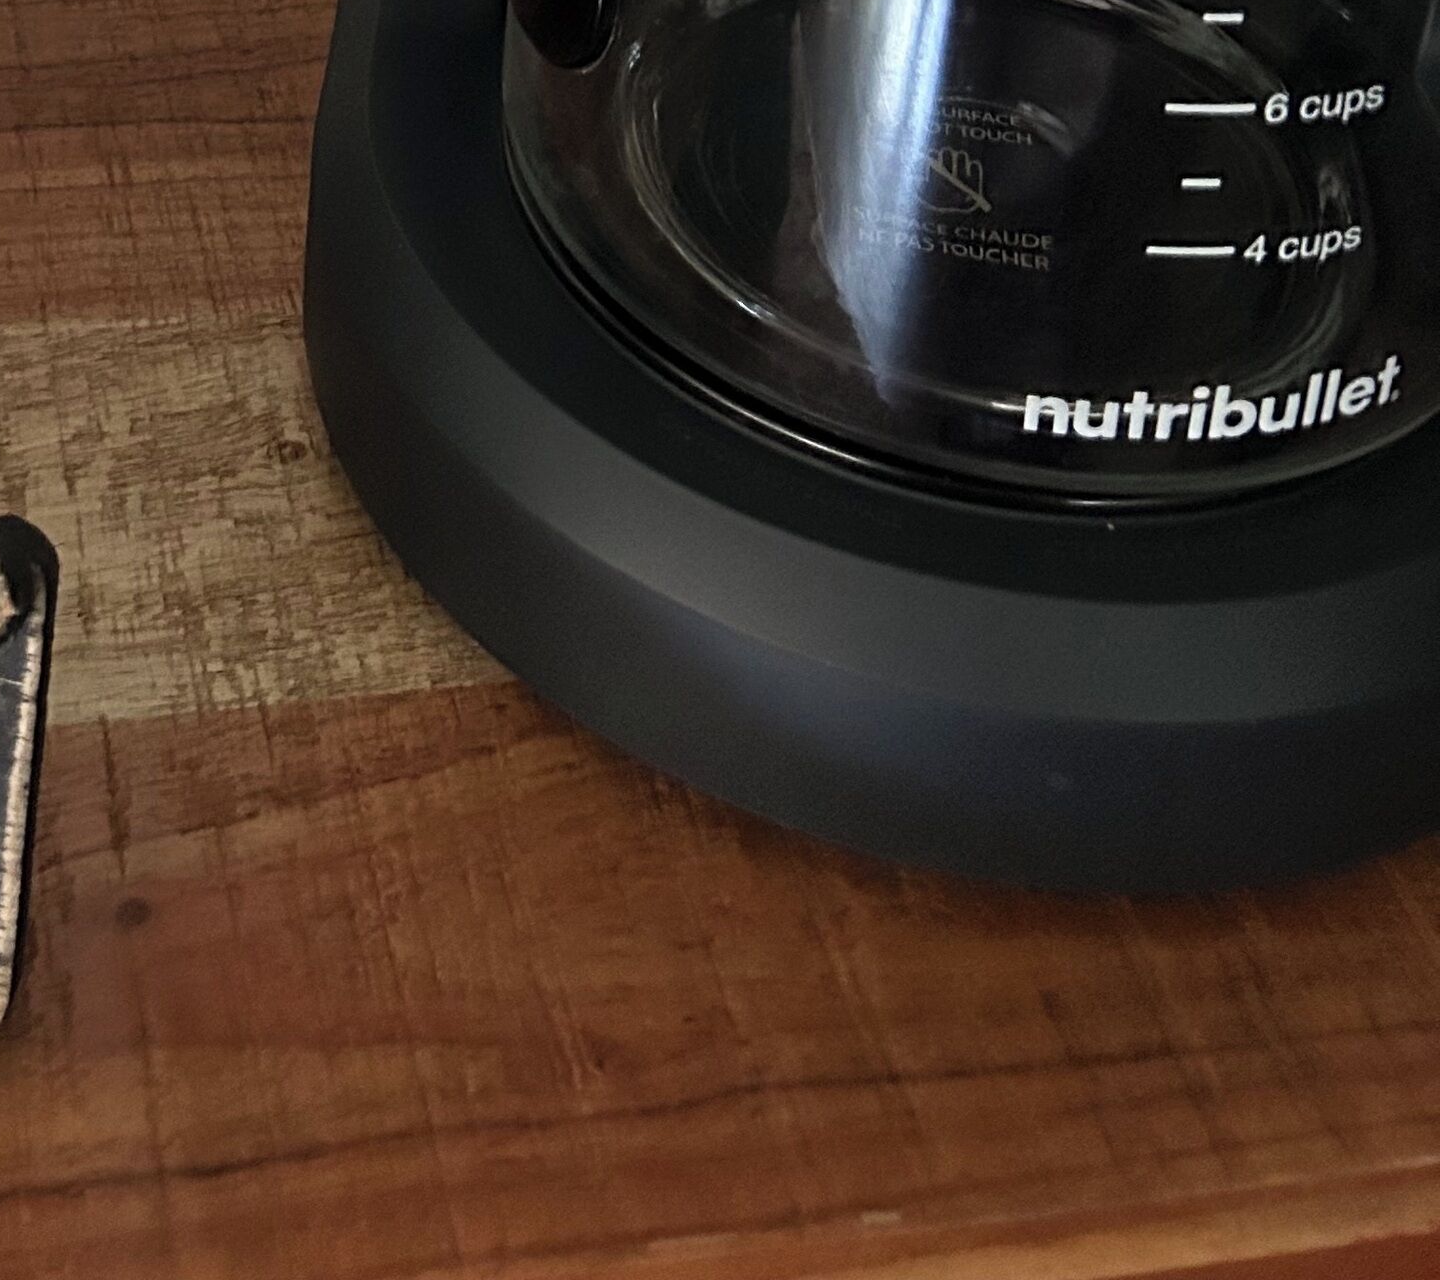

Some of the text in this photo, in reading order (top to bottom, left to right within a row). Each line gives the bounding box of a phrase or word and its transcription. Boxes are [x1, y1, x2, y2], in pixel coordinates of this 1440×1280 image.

[1264, 85, 1385, 124] 6 cups
[960, 125, 1033, 146] TOUCH
[894, 232, 935, 253] PAS
[942, 240, 1050, 271] TOUCHER
[954, 226, 1054, 251] CHAUDE
[1243, 225, 1362, 265] 4 cups
